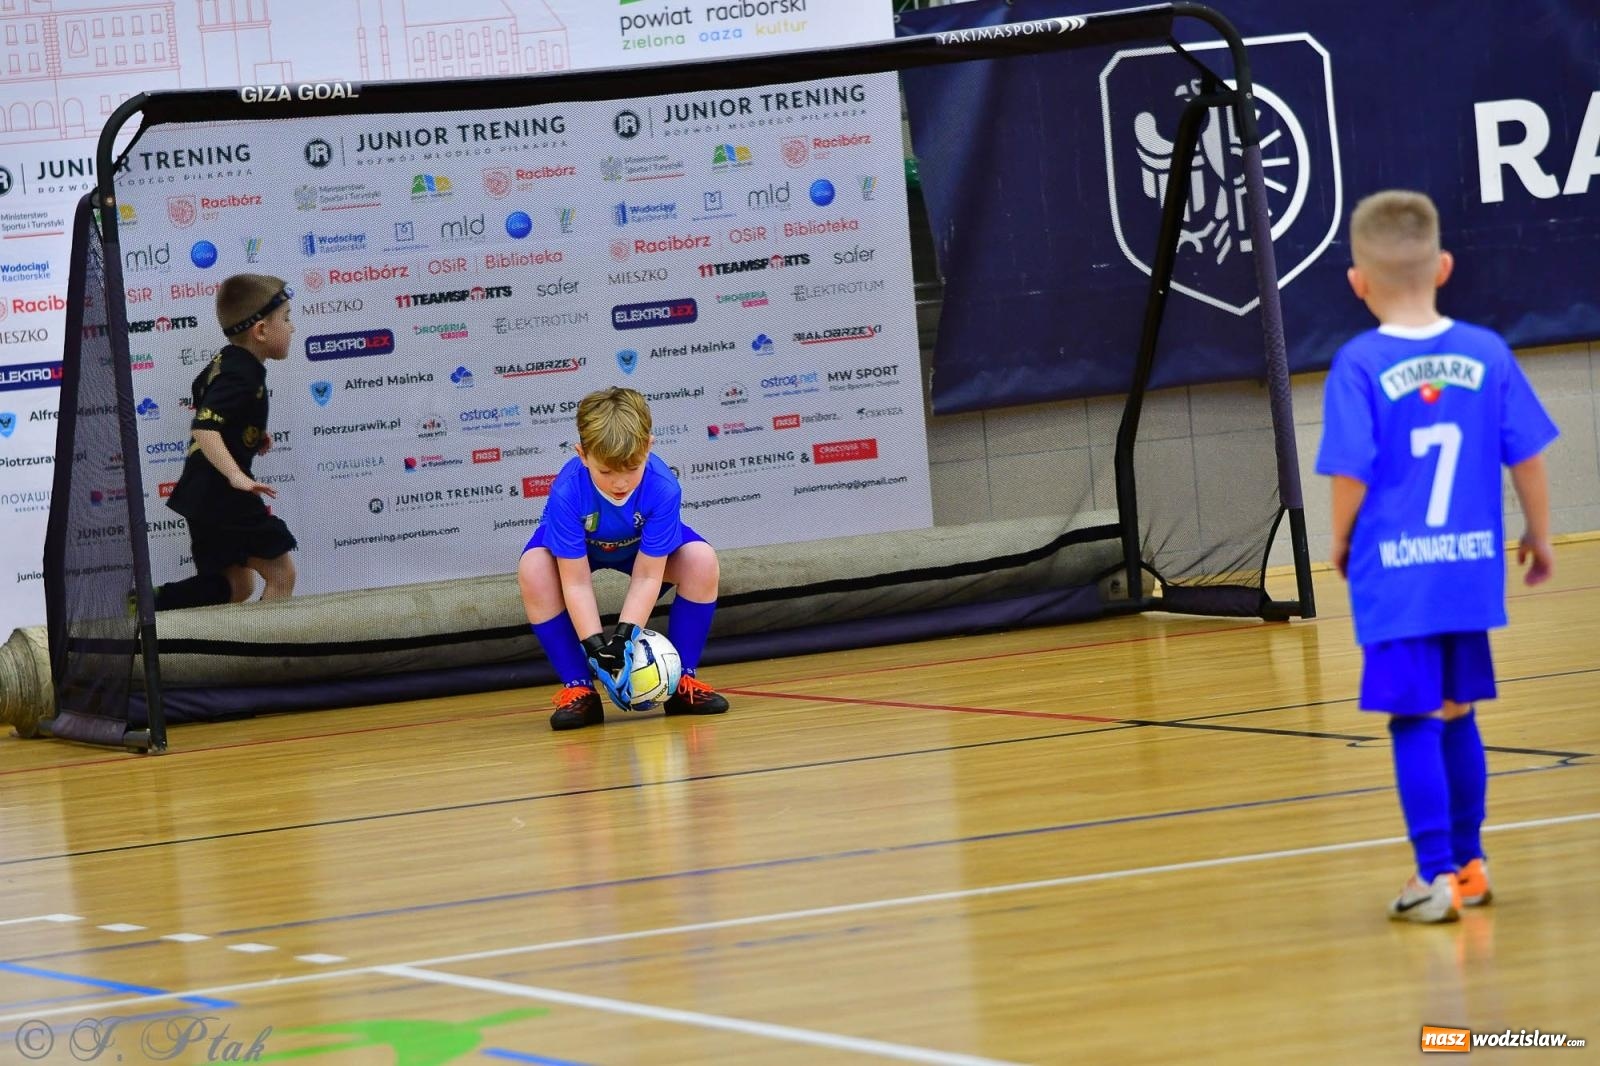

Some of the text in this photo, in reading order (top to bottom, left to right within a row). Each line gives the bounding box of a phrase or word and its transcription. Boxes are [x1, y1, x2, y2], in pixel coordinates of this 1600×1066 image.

[620, 0, 806, 36] powiat raciborski
[622, 19, 808, 50] zielona oaza kultur
[938, 20, 1053, 45] YAKIMASPORT
[241, 83, 359, 103] GIZA GOAL
[664, 84, 866, 123] JUNIOR TRENING
[357, 115, 566, 153] JUNIOR TRENING
[812, 133, 872, 149] Racibórz
[38, 143, 250, 180] JUNIR TRENING
[515, 165, 577, 181] Racibórz
[201, 193, 262, 210] Racibórz
[748, 182, 790, 208] mld
[0, 211, 48, 222] Ministerstwo
[1, 223, 26, 232] Sportu
[31, 219, 64, 229] Turystyki
[441, 214, 485, 239] mld
[633, 218, 859, 254] Racibórz OSiR Biblioteka
[833, 245, 875, 266] safer
[0, 261, 49, 274] Wodociągi
[2, 271, 51, 282] Raciborskie
[328, 249, 563, 285] Racibórz OSiR Biblioteka
[608, 267, 668, 286] MIESZKO
[127, 287, 153, 305] SiR
[170, 282, 222, 300] Bibliot
[537, 278, 579, 298] safer
[791, 279, 884, 302] ELEKTROTUM
[302, 299, 363, 316] MIESZKO
[492, 311, 589, 335] ELEKTROTUM
[0, 327, 48, 345] IESZKO
[308, 336, 391, 354] ELEKTROLEX
[650, 340, 735, 359] Alfred Mainka
[344, 372, 434, 391] Alfred Mainka
[827, 364, 899, 382] MW SPORT
[1386, 360, 1475, 391] TYMBARK
[29, 408, 61, 422] Alfre
[530, 400, 580, 416] MW SPO
[313, 417, 402, 437] Piotrzurawik.pl
[691, 459, 737, 475] JUNIOR
[740, 451, 795, 468] TRENING
[800, 452, 810, 463] &
[1410, 422, 1462, 528] 7
[396, 490, 444, 506] JUNIOR
[447, 484, 503, 501] TRENING
[509, 485, 519, 497] &
[147, 518, 186, 534] ENING
